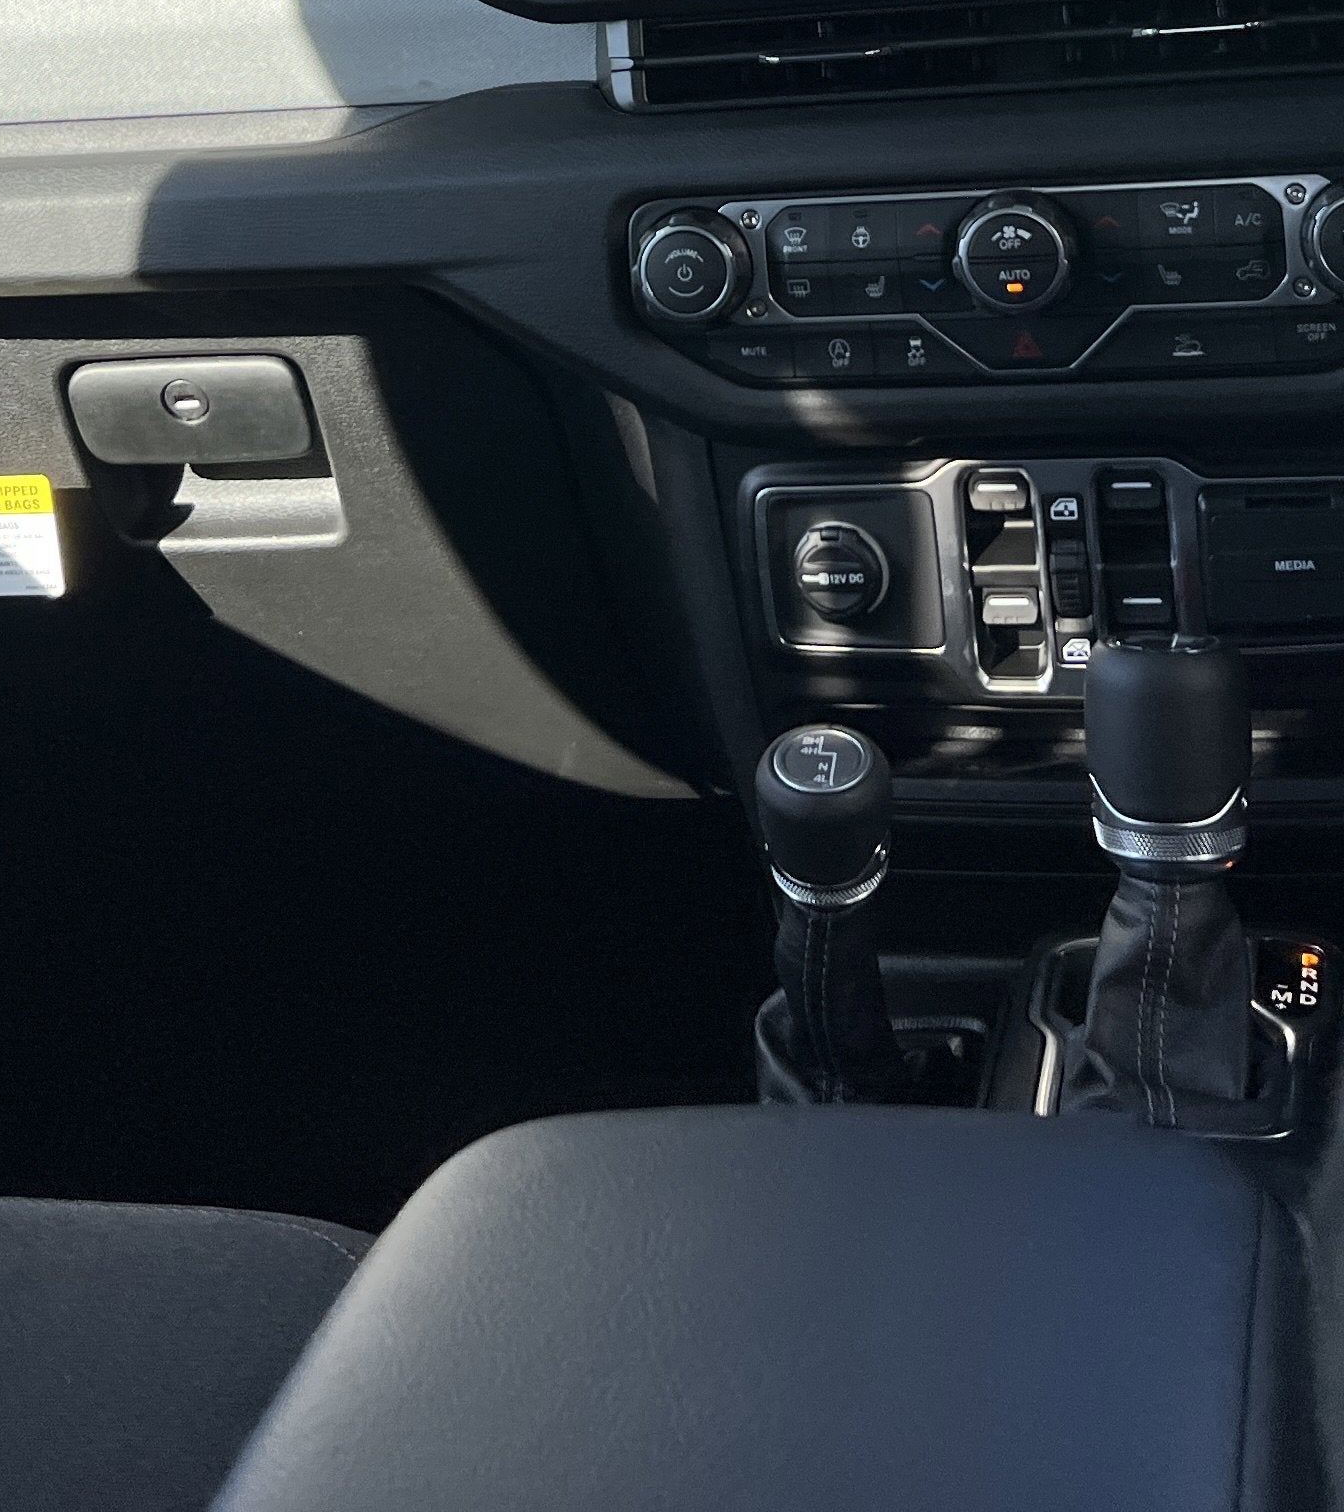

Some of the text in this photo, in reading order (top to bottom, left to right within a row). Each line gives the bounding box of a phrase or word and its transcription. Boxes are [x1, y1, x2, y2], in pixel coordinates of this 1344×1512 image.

[1234, 212, 1263, 227] A/C
[999, 239, 1022, 251] OFF
[669, 249, 698, 258] VOLUME
[998, 269, 1031, 281] AUTO
[1296, 322, 1337, 332] SCREEN
[741, 346, 768, 356] MUTE
[832, 357, 850, 368] OFF
[908, 356, 926, 366] OFF
[5, 499, 41, 510] BAGS
[1275, 559, 1316, 572] MEDIA
[829, 573, 865, 585] 12V DC
[1301, 967, 1318, 980] R
[1300, 980, 1319, 993] N
[1271, 989, 1293, 1004] M
[1299, 993, 1317, 1006] D
